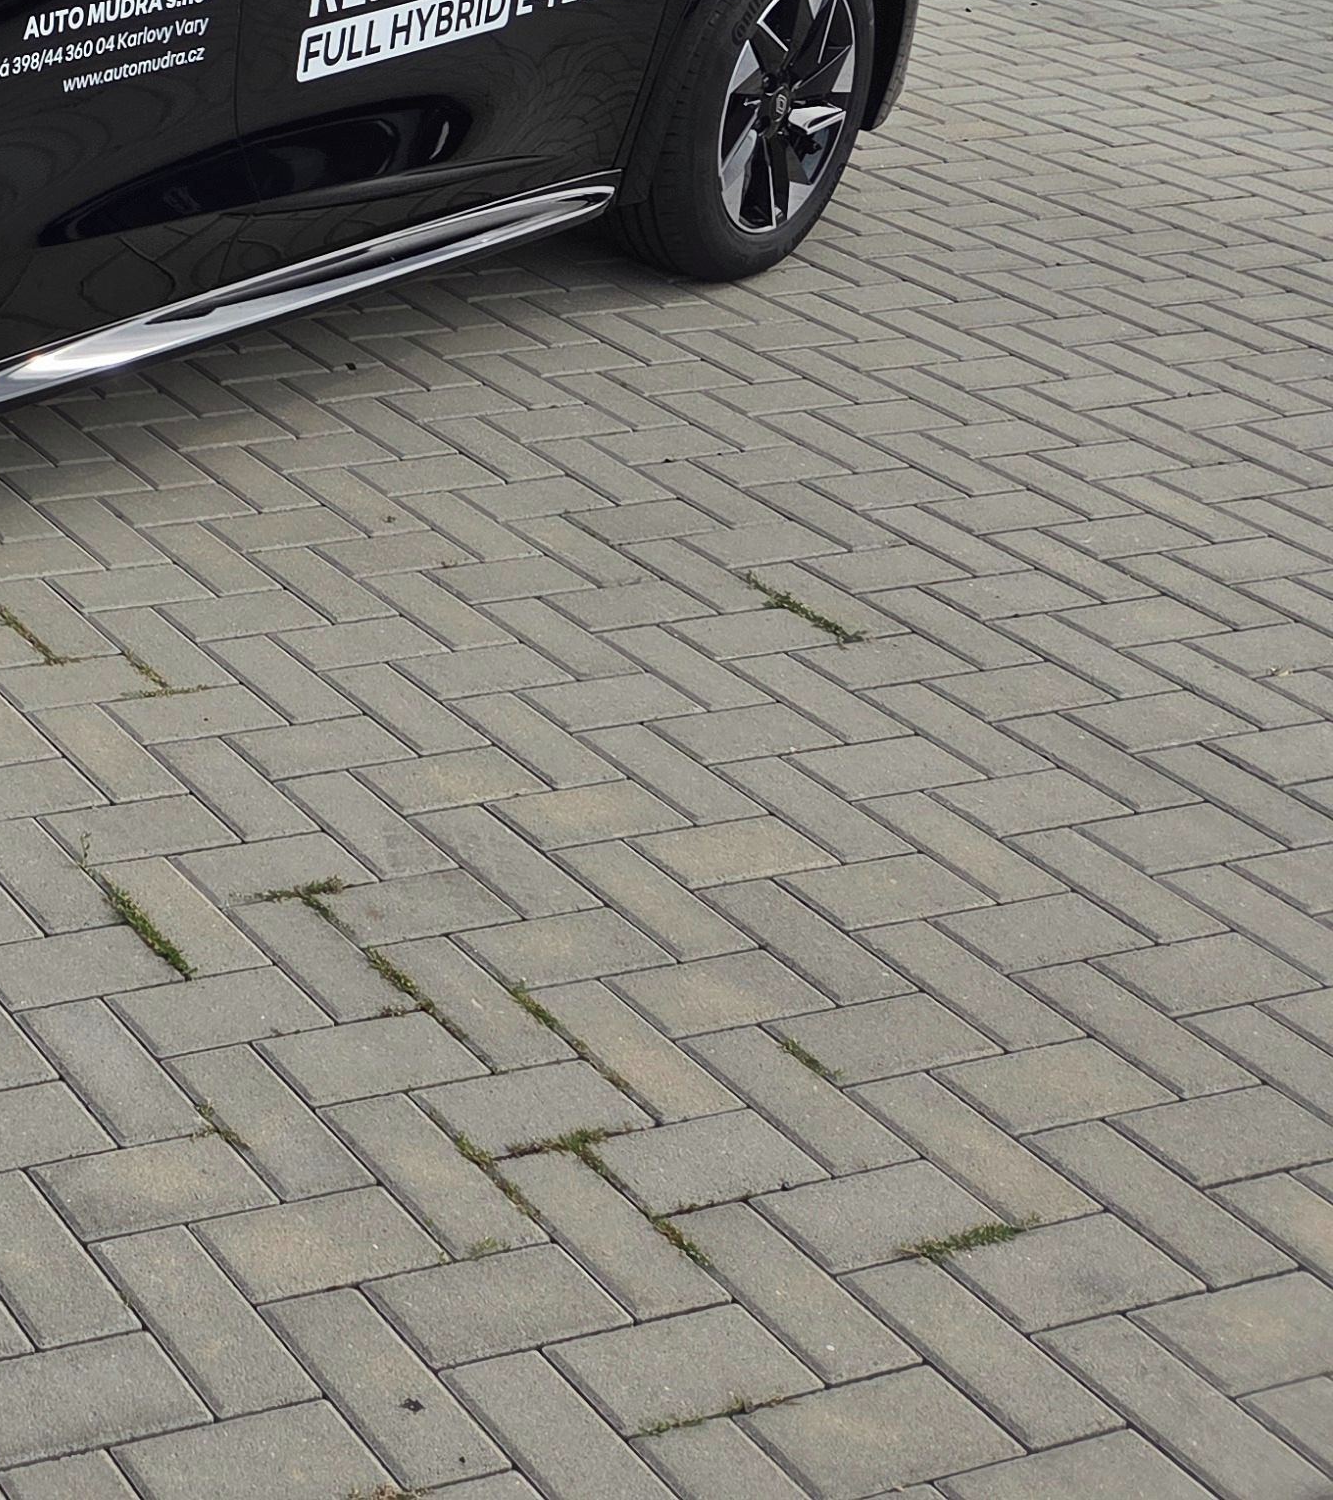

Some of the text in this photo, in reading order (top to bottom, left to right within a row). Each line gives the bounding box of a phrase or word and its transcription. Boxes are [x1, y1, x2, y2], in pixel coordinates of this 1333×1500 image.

[12, 48, 63, 74] 398/44
[65, 41, 93, 62] 360
[95, 35, 116, 55] 04
[117, 23, 173, 49] Karlovy
[175, 16, 210, 37] Vary
[23, 7, 84, 40] AUTO
[302, 19, 381, 73] FULL
[63, 47, 206, 93] www.automudra.cz
